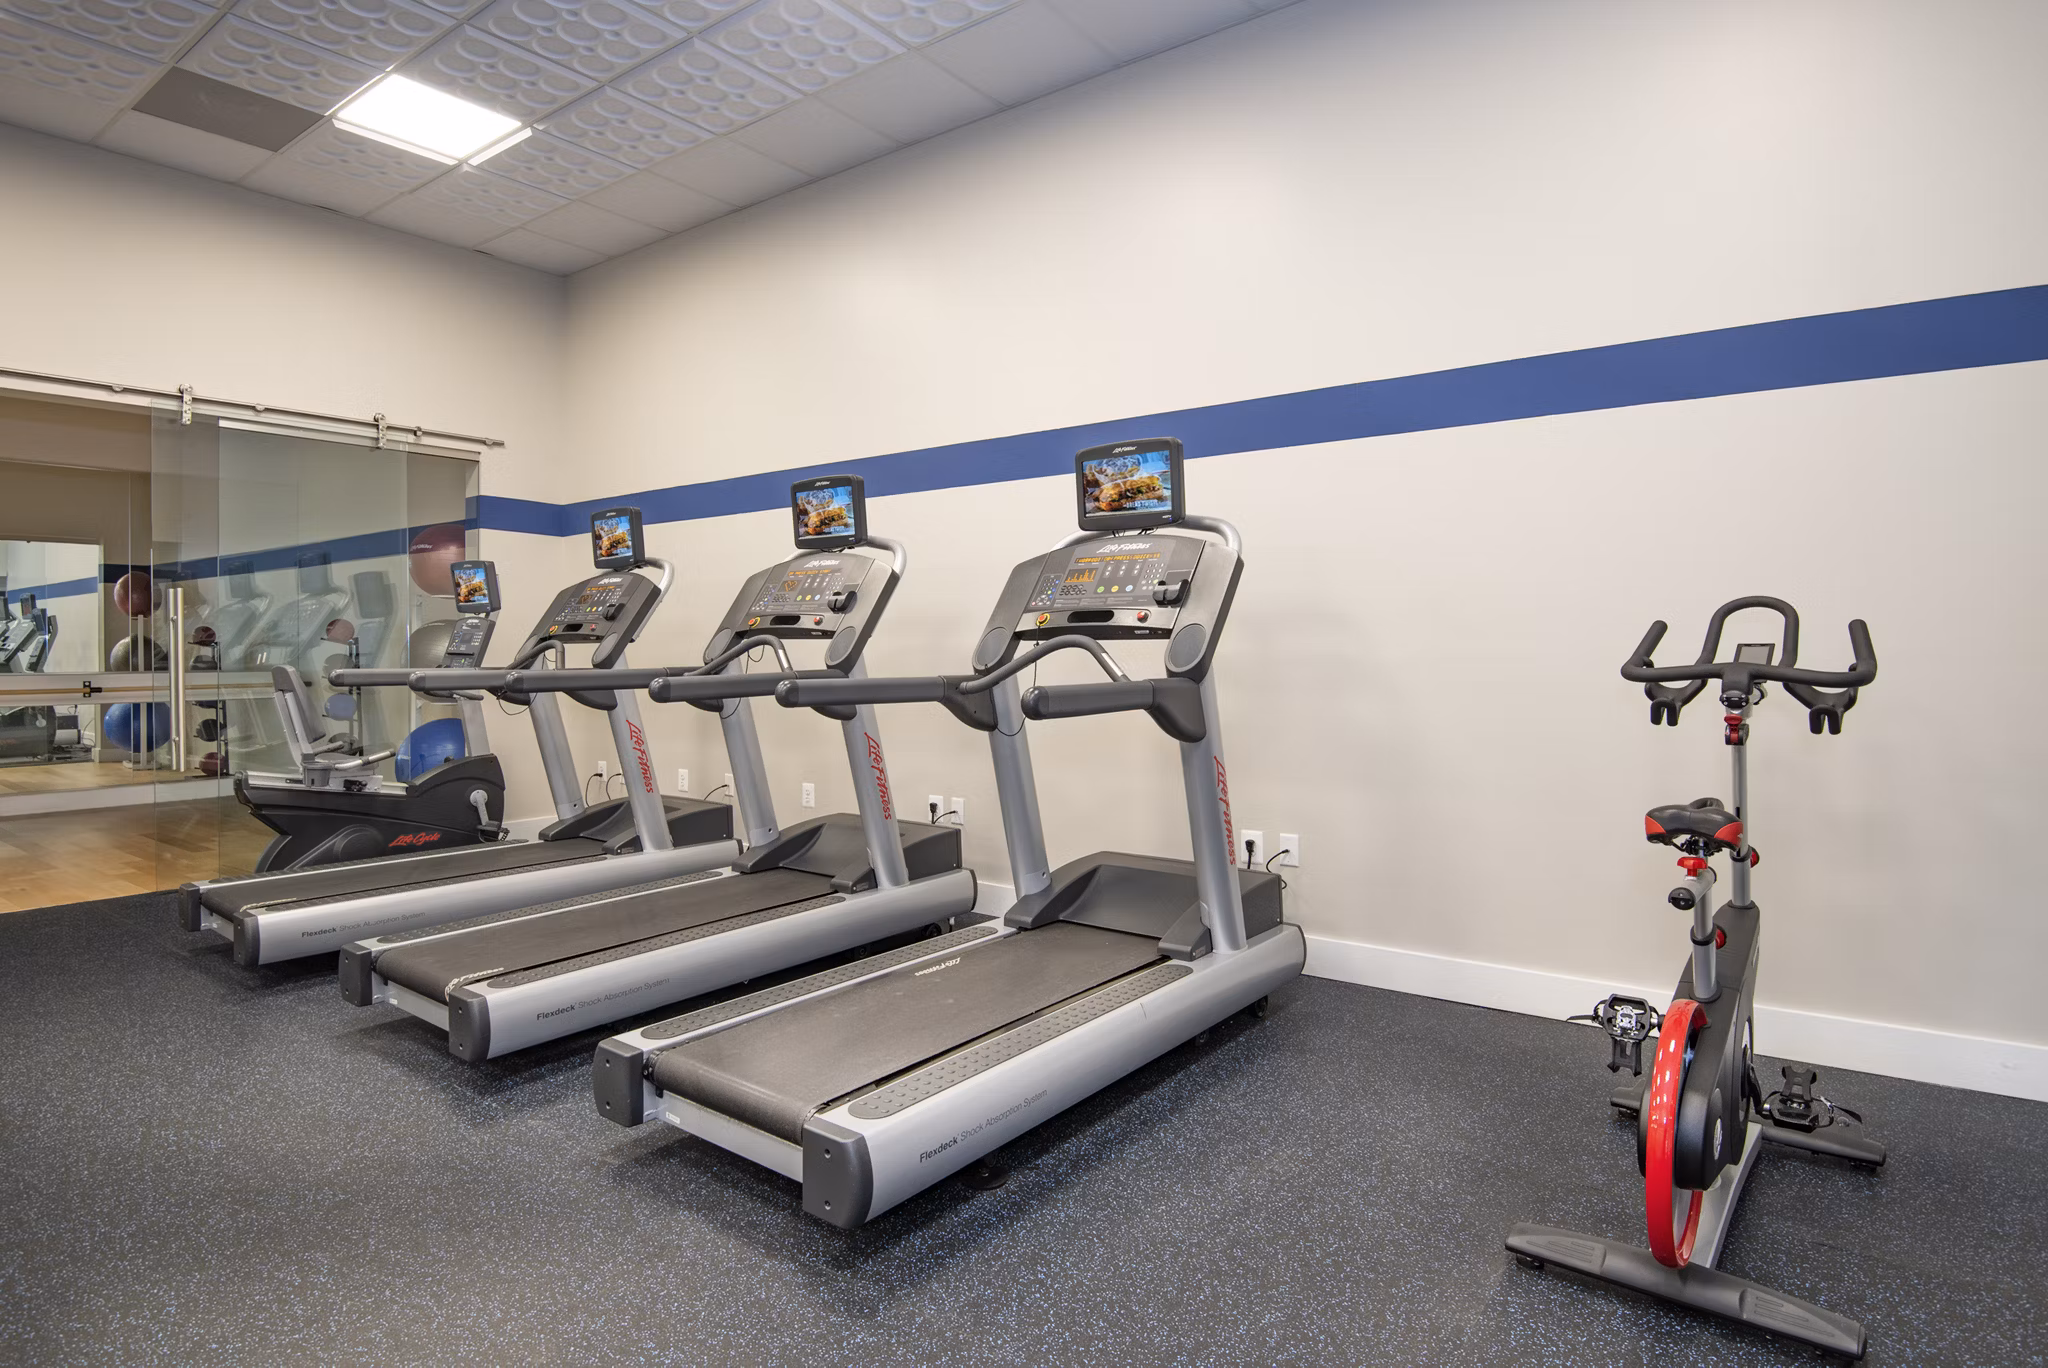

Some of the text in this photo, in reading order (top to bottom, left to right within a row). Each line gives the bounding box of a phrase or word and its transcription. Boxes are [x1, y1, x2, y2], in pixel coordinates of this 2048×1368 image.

[301, 926, 337, 938] Flexdeck
[339, 921, 362, 932] Shock
[400, 911, 426, 922] System
[536, 977, 671, 1021] Flexdeck Shock Absorption System
[919, 1088, 1048, 1164] Flexdeck Shock Absorption System
